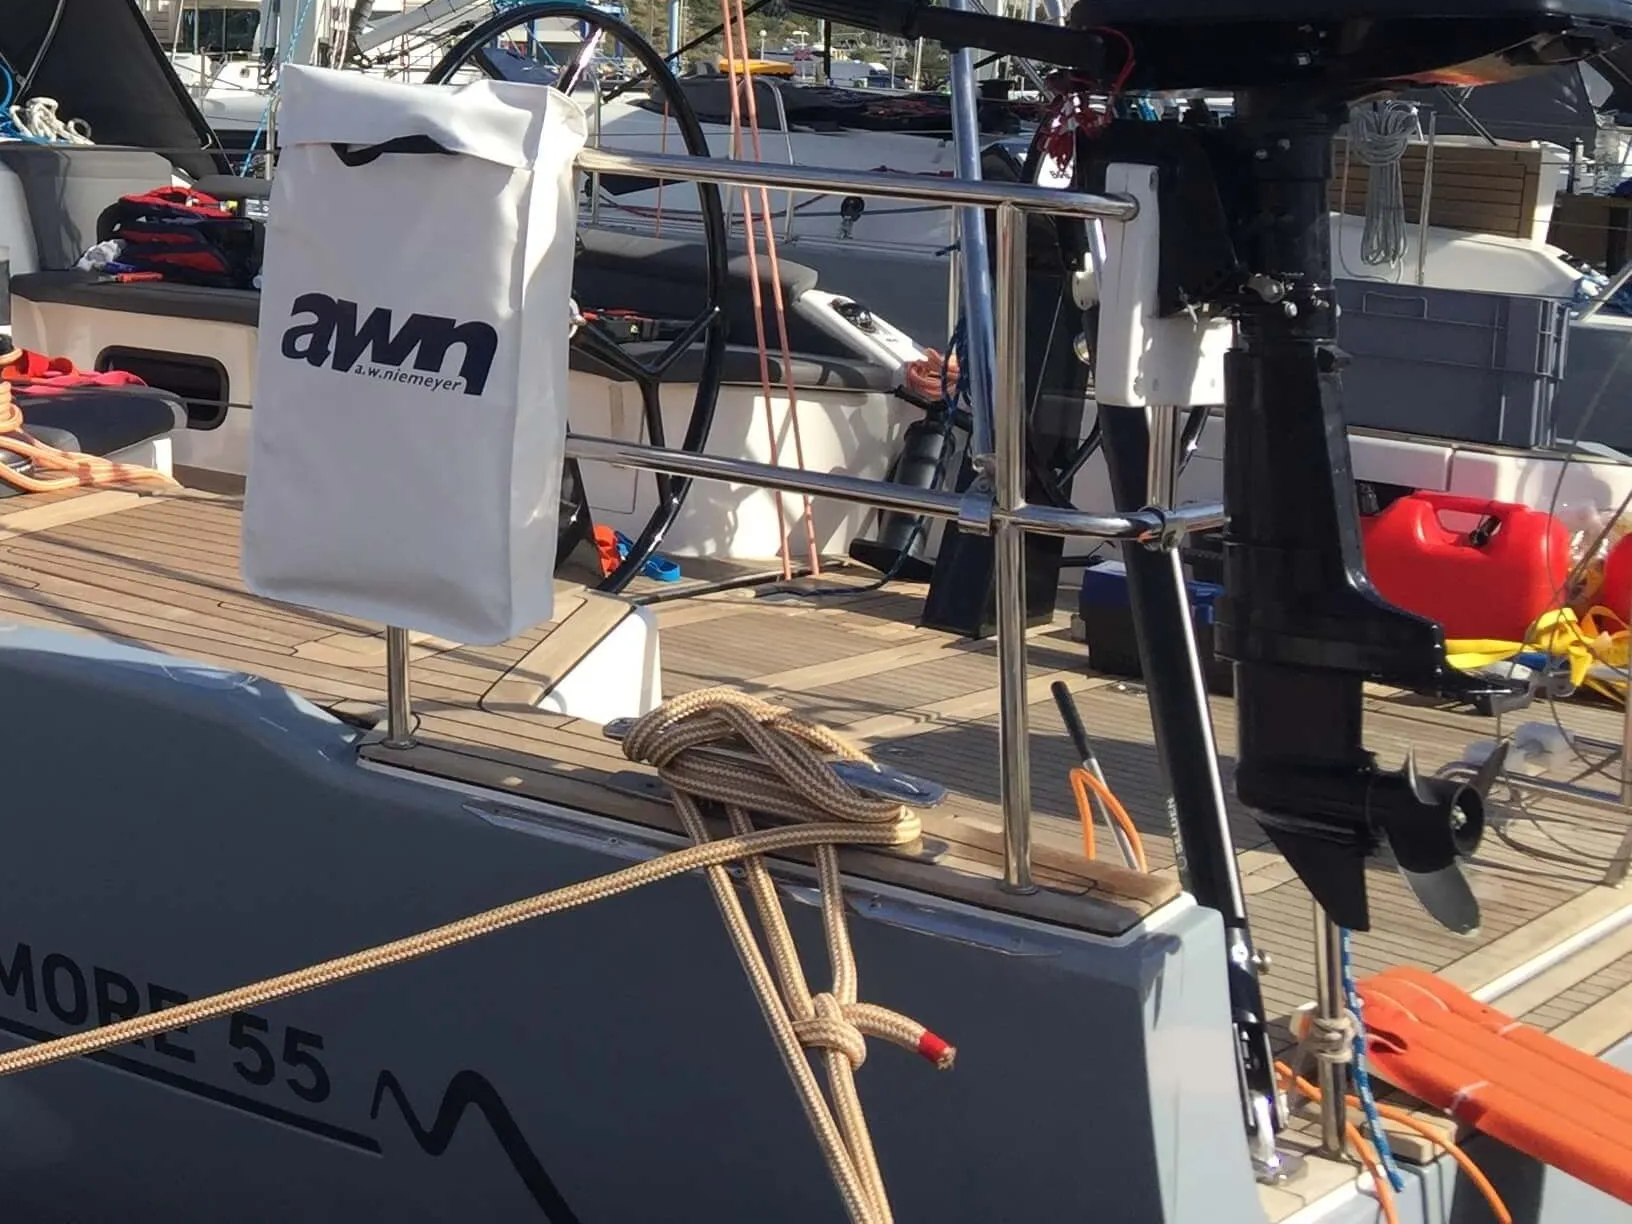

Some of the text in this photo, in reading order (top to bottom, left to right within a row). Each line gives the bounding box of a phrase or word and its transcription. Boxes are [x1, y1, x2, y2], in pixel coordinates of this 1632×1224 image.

[281, 293, 498, 396] awn
[354, 364, 462, 392] a.w.niemeyer
[228, 1012, 331, 1103] 55
